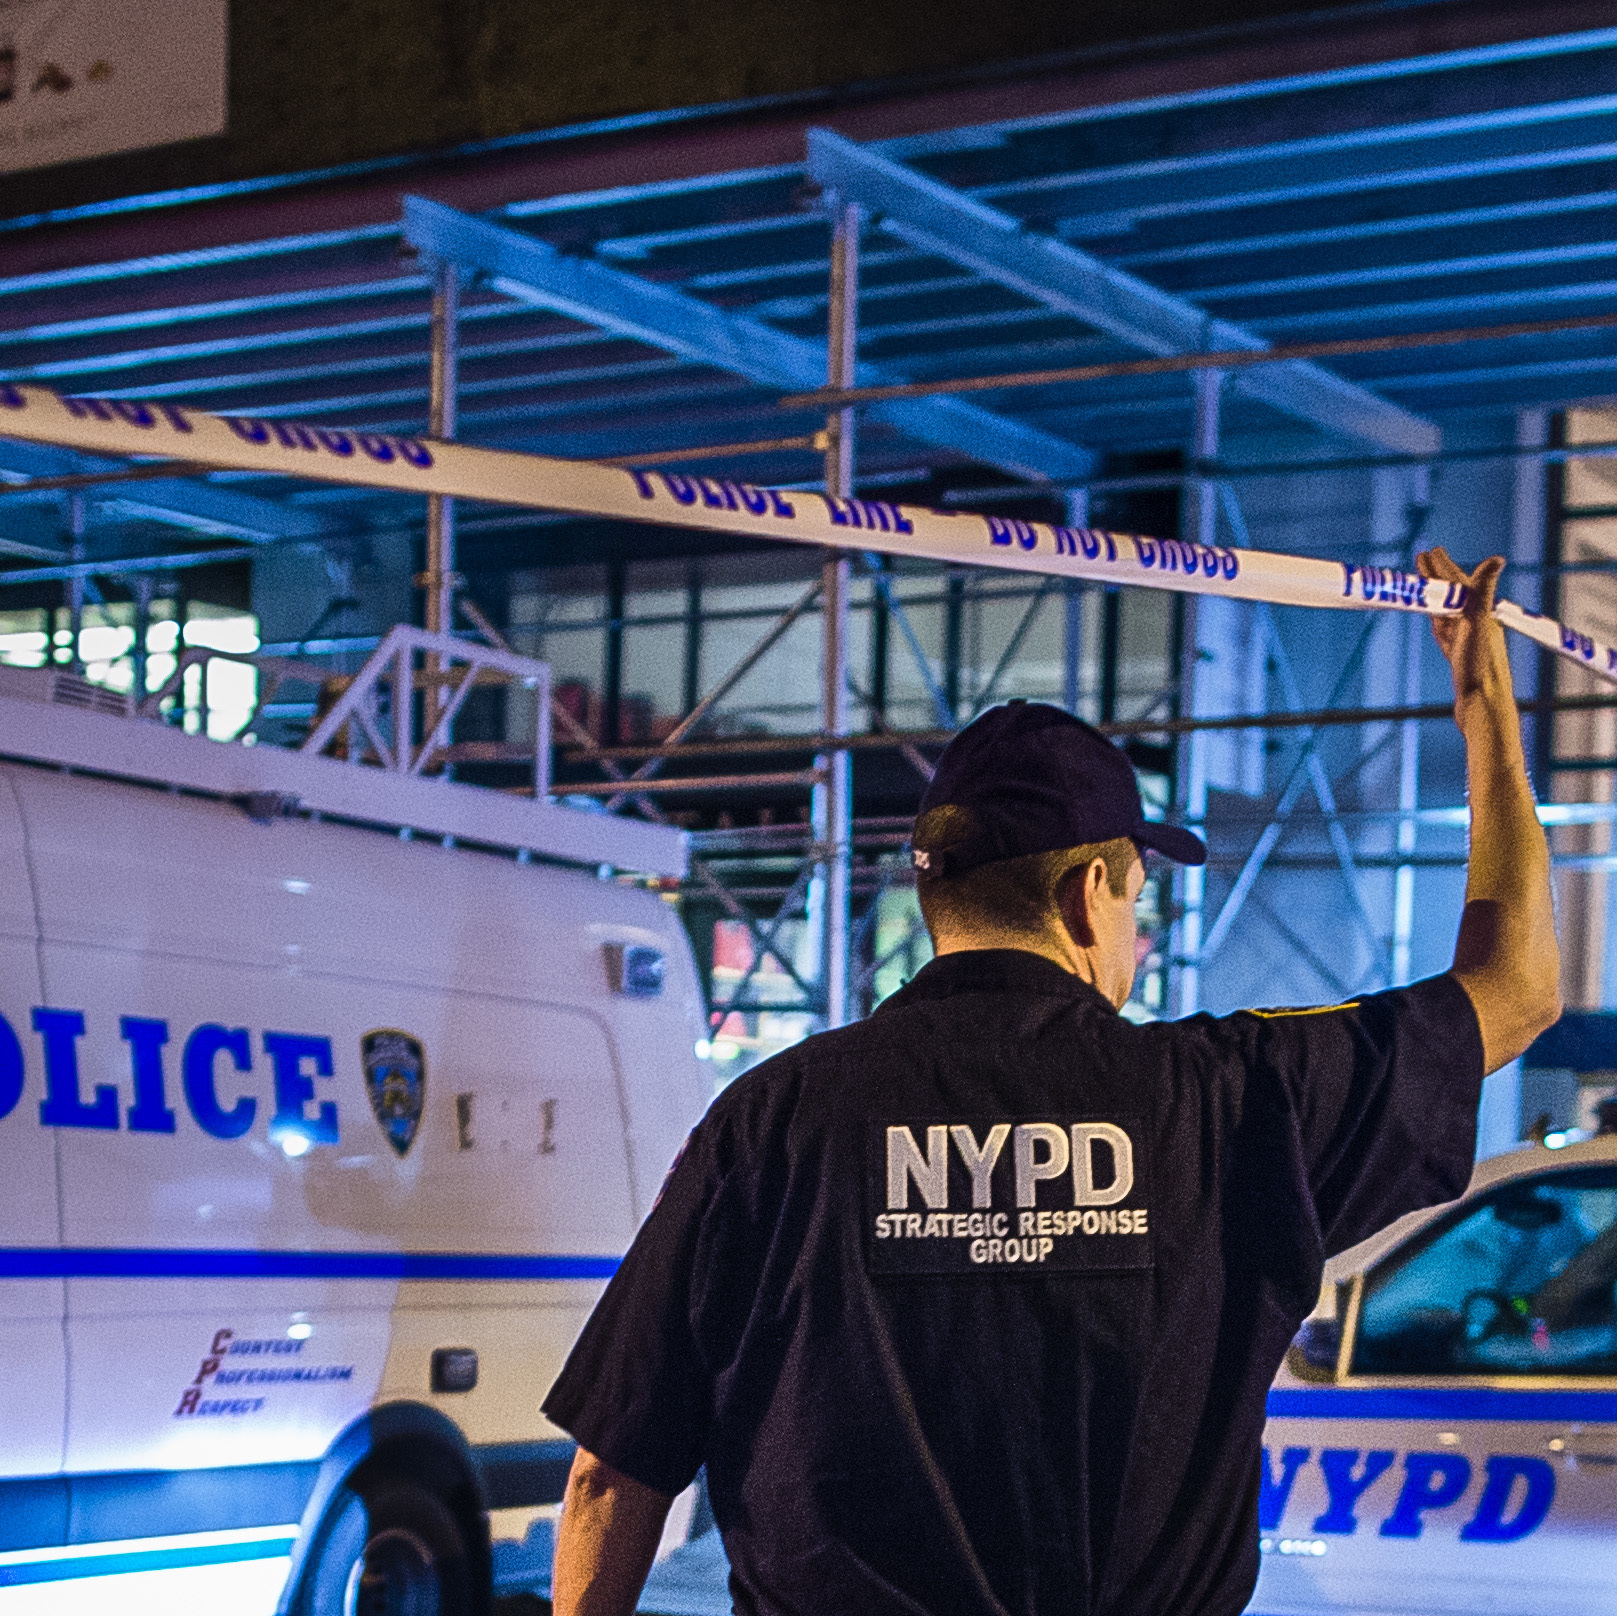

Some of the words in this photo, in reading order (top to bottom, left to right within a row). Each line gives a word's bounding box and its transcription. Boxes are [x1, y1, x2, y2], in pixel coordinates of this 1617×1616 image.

[886, 1122, 1134, 1210] NYPD
[875, 1212, 1010, 1239] STRATEGIC
[1018, 1209, 1149, 1237] RESPONSE
[969, 1237, 1055, 1264] GROUP
[1258, 1446, 1556, 1543] NYPD
